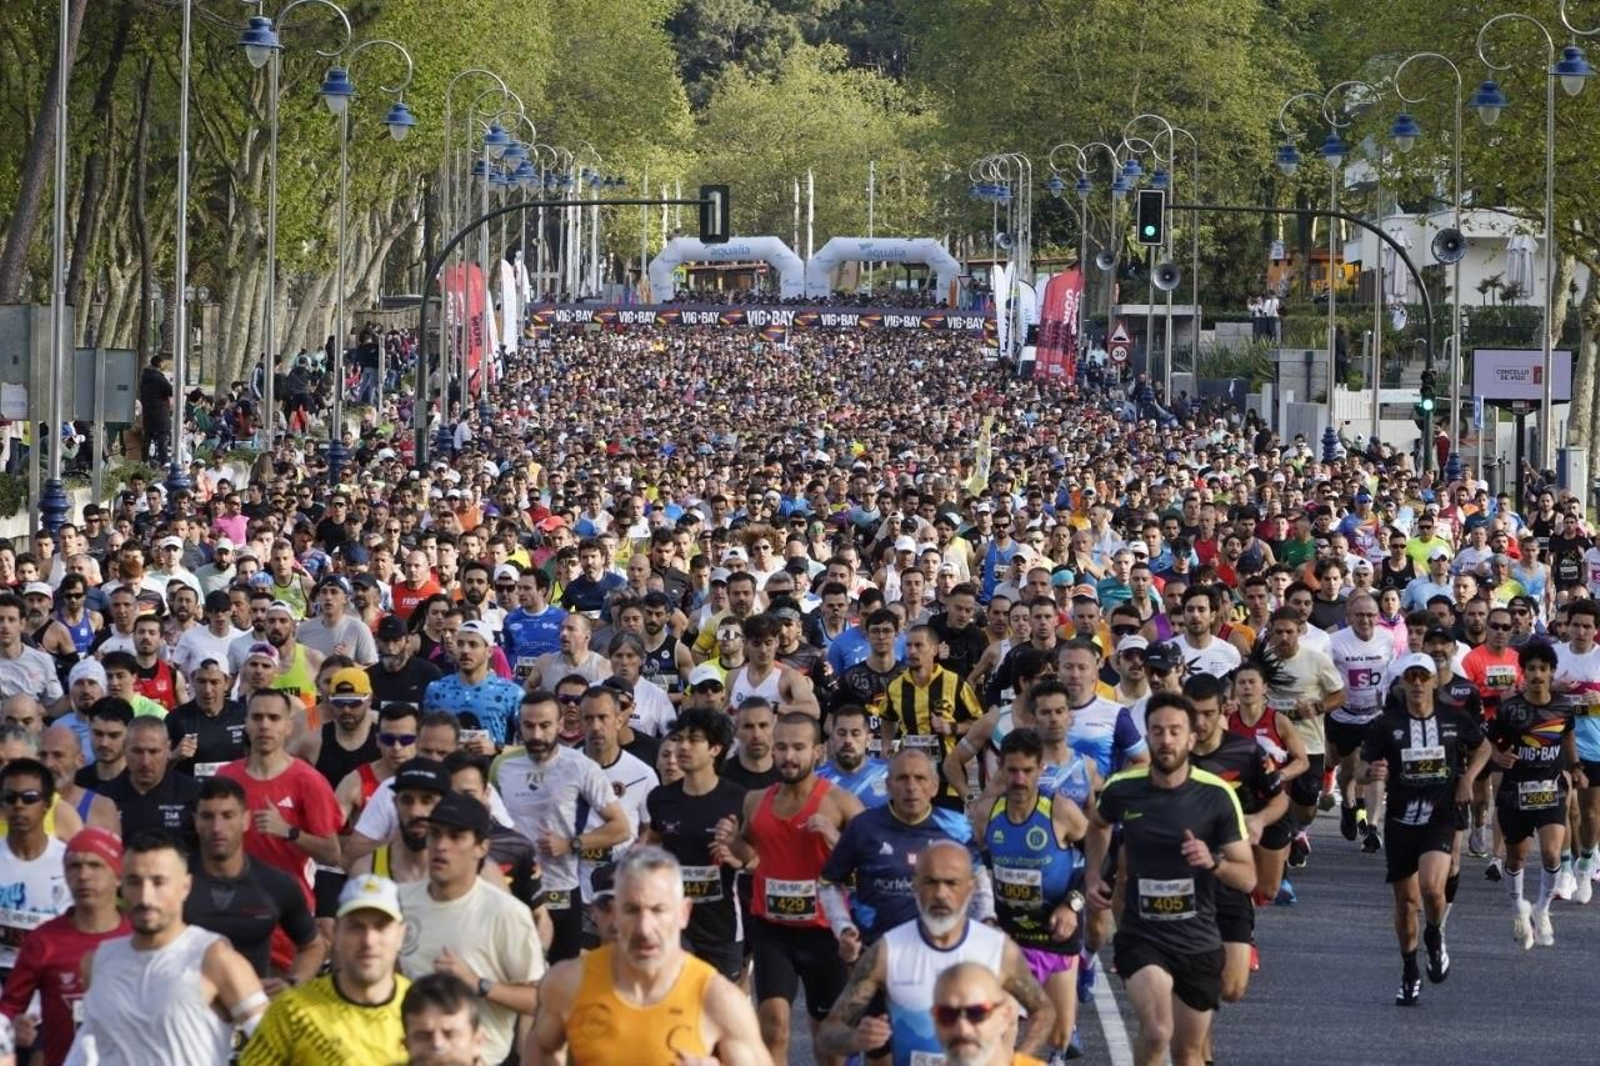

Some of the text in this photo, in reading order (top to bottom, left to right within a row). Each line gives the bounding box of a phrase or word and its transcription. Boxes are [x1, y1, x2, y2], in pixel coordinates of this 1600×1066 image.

[710, 245, 751, 257] aqualia
[866, 247, 907, 258] aqualia
[1114, 350, 1125, 358] 30
[852, 673, 870, 689] 25
[1508, 704, 1526, 721] 25
[1418, 760, 1433, 771] 22
[1003, 884, 1030, 898] 909
[777, 898, 806, 911] 429
[1153, 897, 1183, 911] 405
